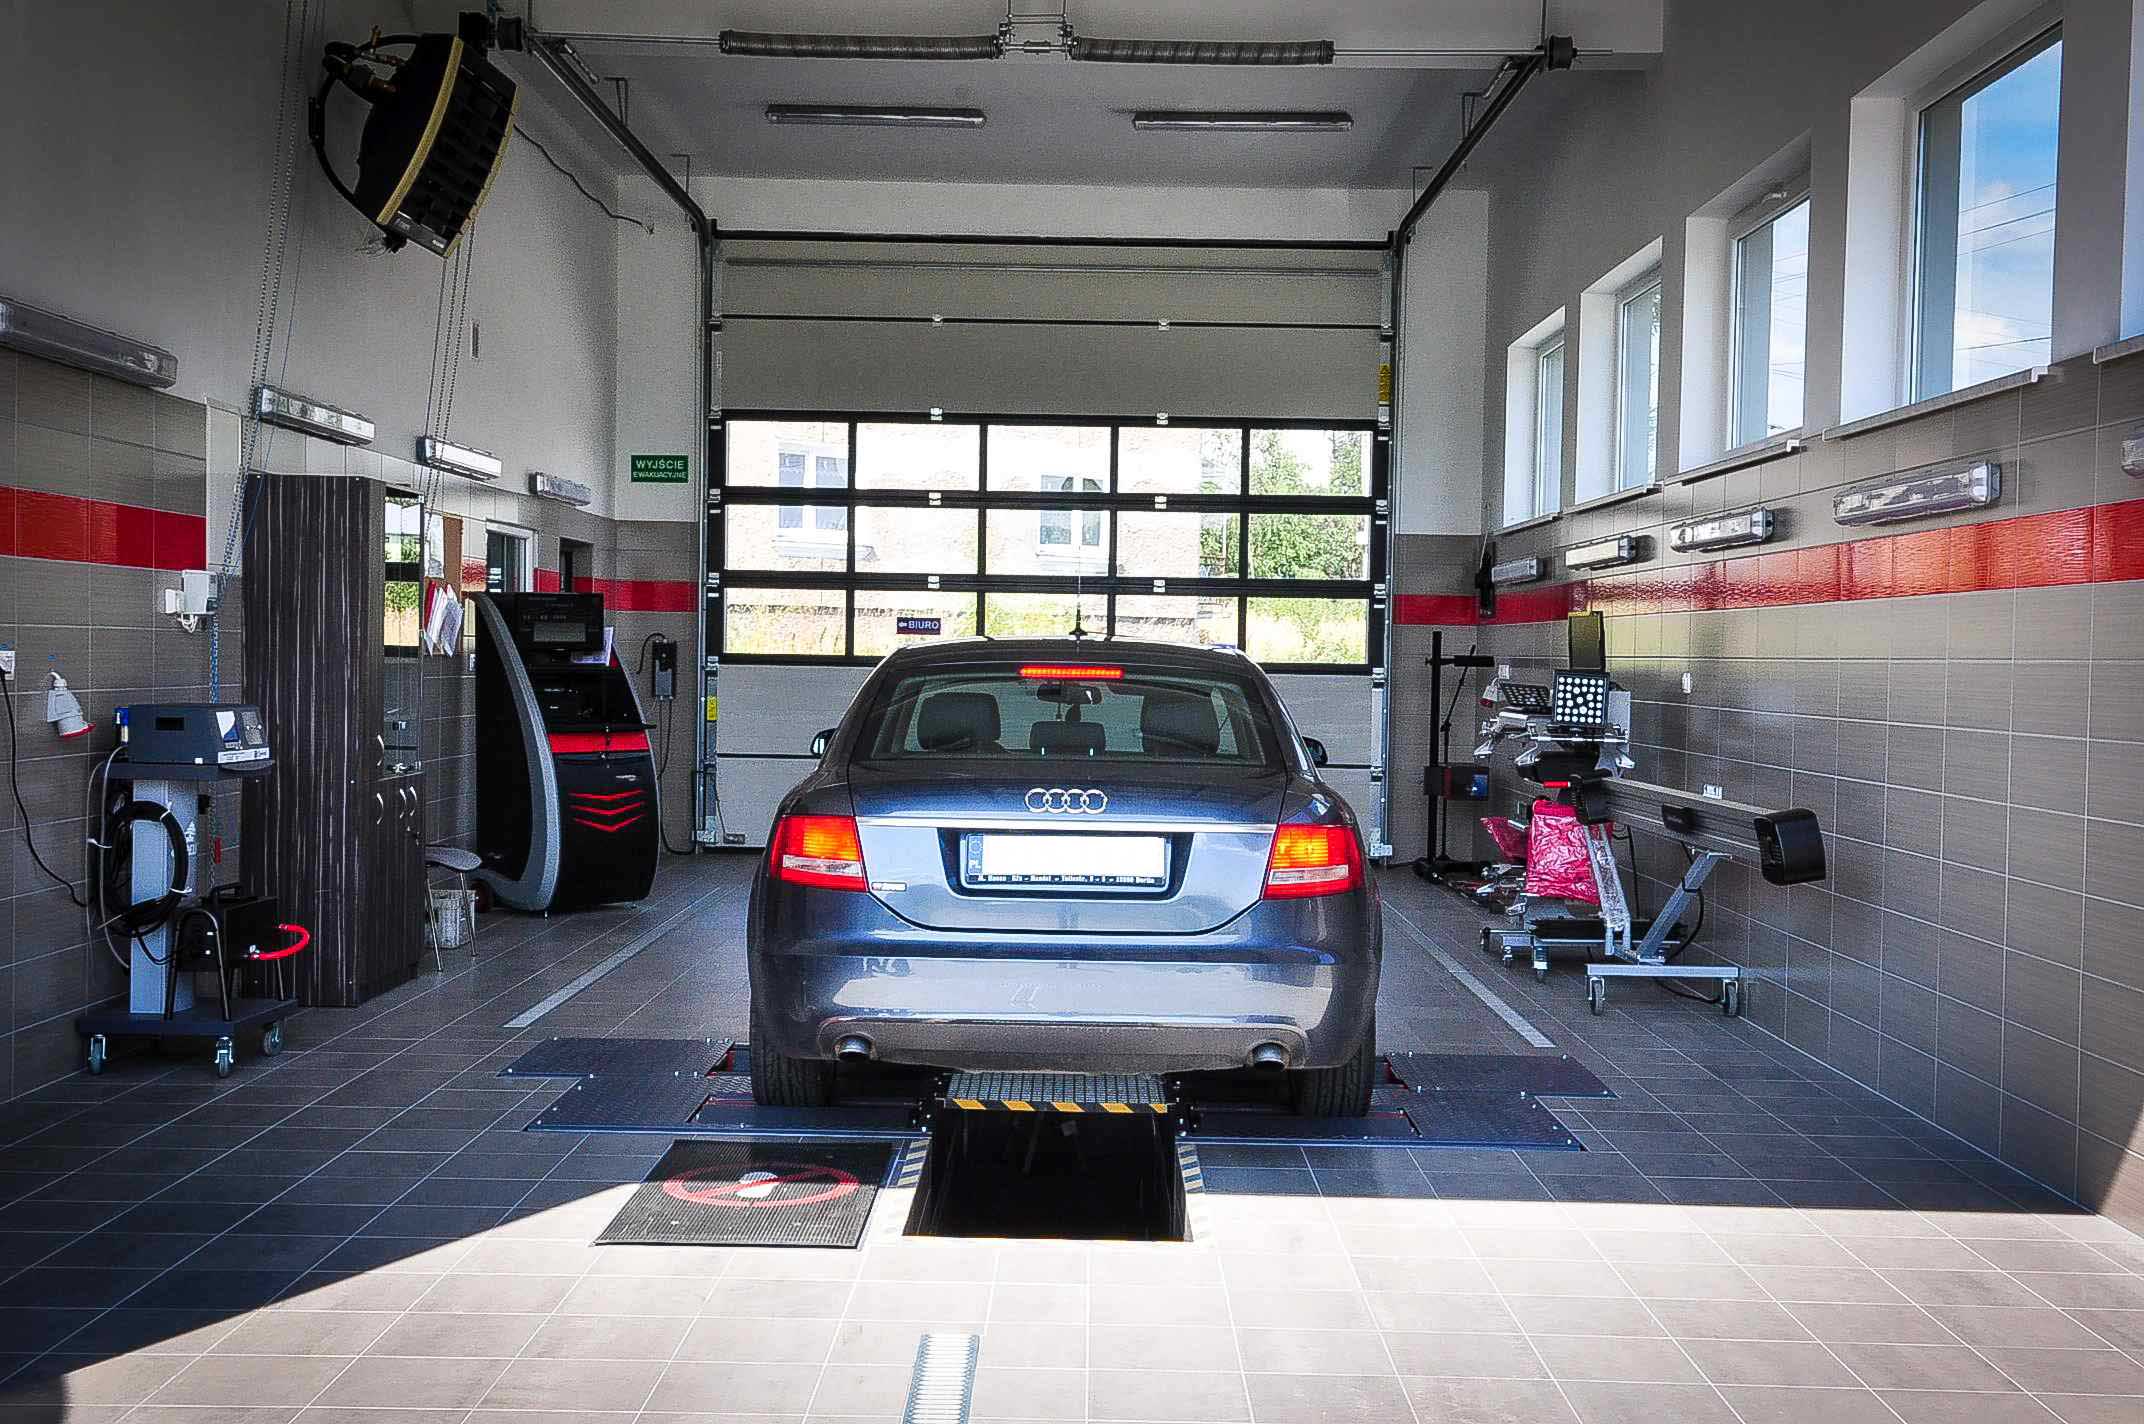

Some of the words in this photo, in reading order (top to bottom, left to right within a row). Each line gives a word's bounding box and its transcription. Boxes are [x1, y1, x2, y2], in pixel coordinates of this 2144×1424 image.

[635, 458, 685, 470] WYJŚCIE
[633, 471, 687, 479] EWAKUACYJNE
[908, 620, 939, 630] BIURO
